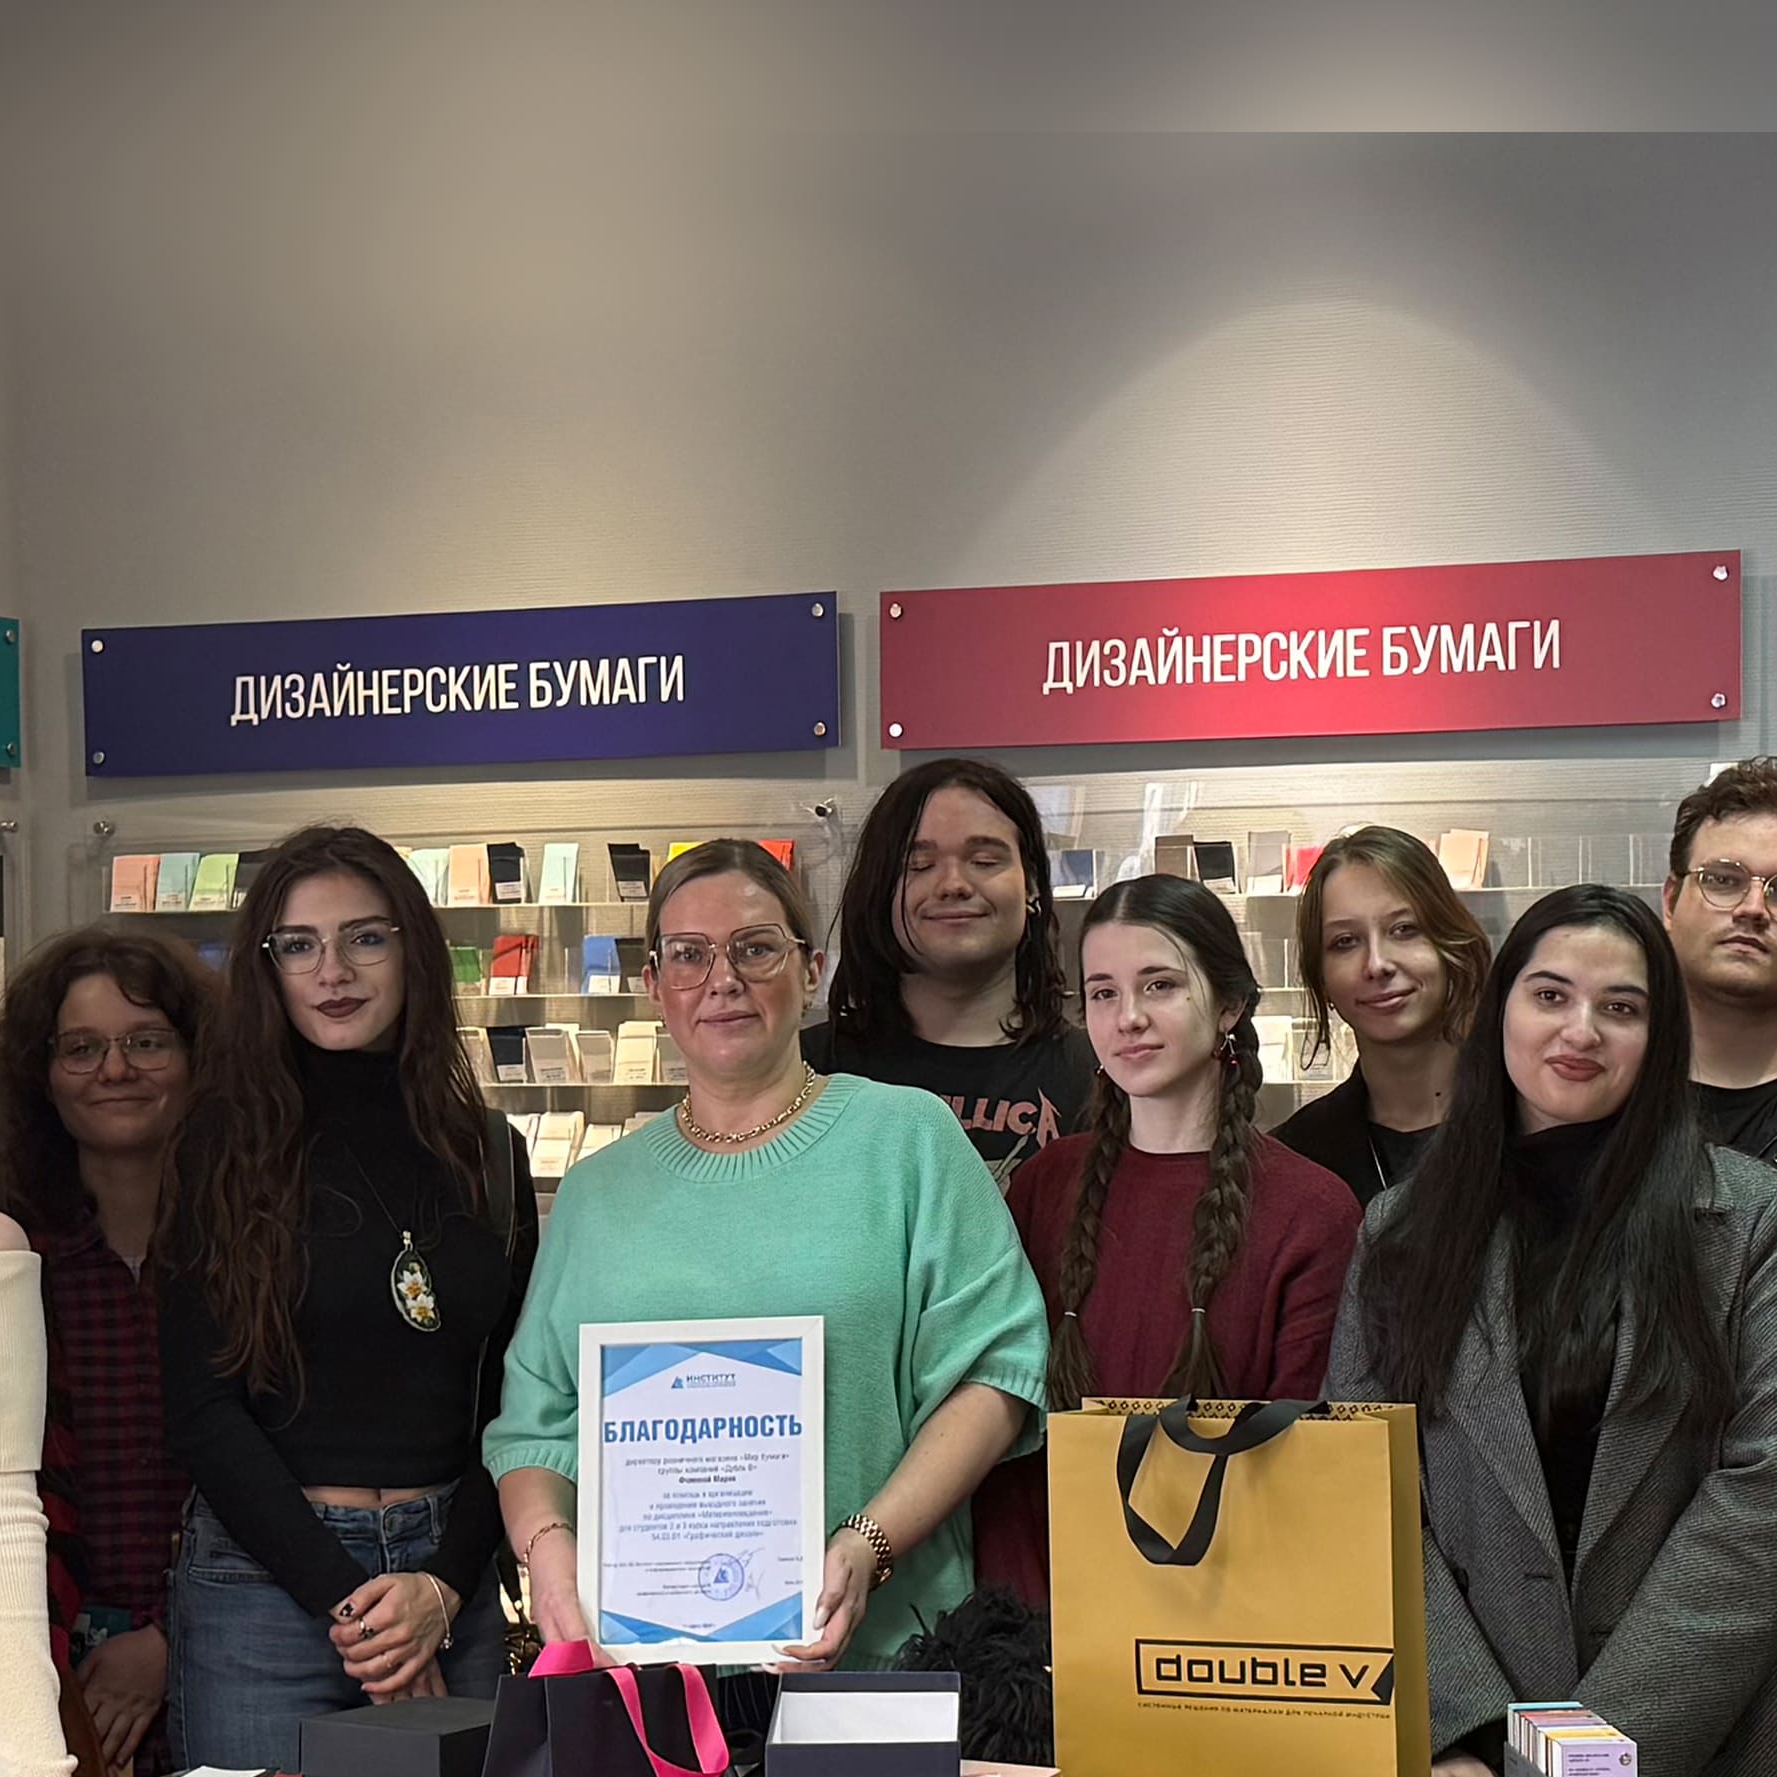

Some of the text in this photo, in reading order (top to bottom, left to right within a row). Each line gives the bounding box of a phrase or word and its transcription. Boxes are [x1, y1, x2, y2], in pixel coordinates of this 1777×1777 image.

[1042, 619, 1561, 695] ДИЗАЙНЕРСКИЕ БУМАГИ
[230, 655, 685, 727] ДИЗАЙНЕРСКИЕ БУМАГИ
[604, 1414, 802, 1444] БЛАГОДАРНОСТЬ
[1154, 1653, 1327, 1688] double
